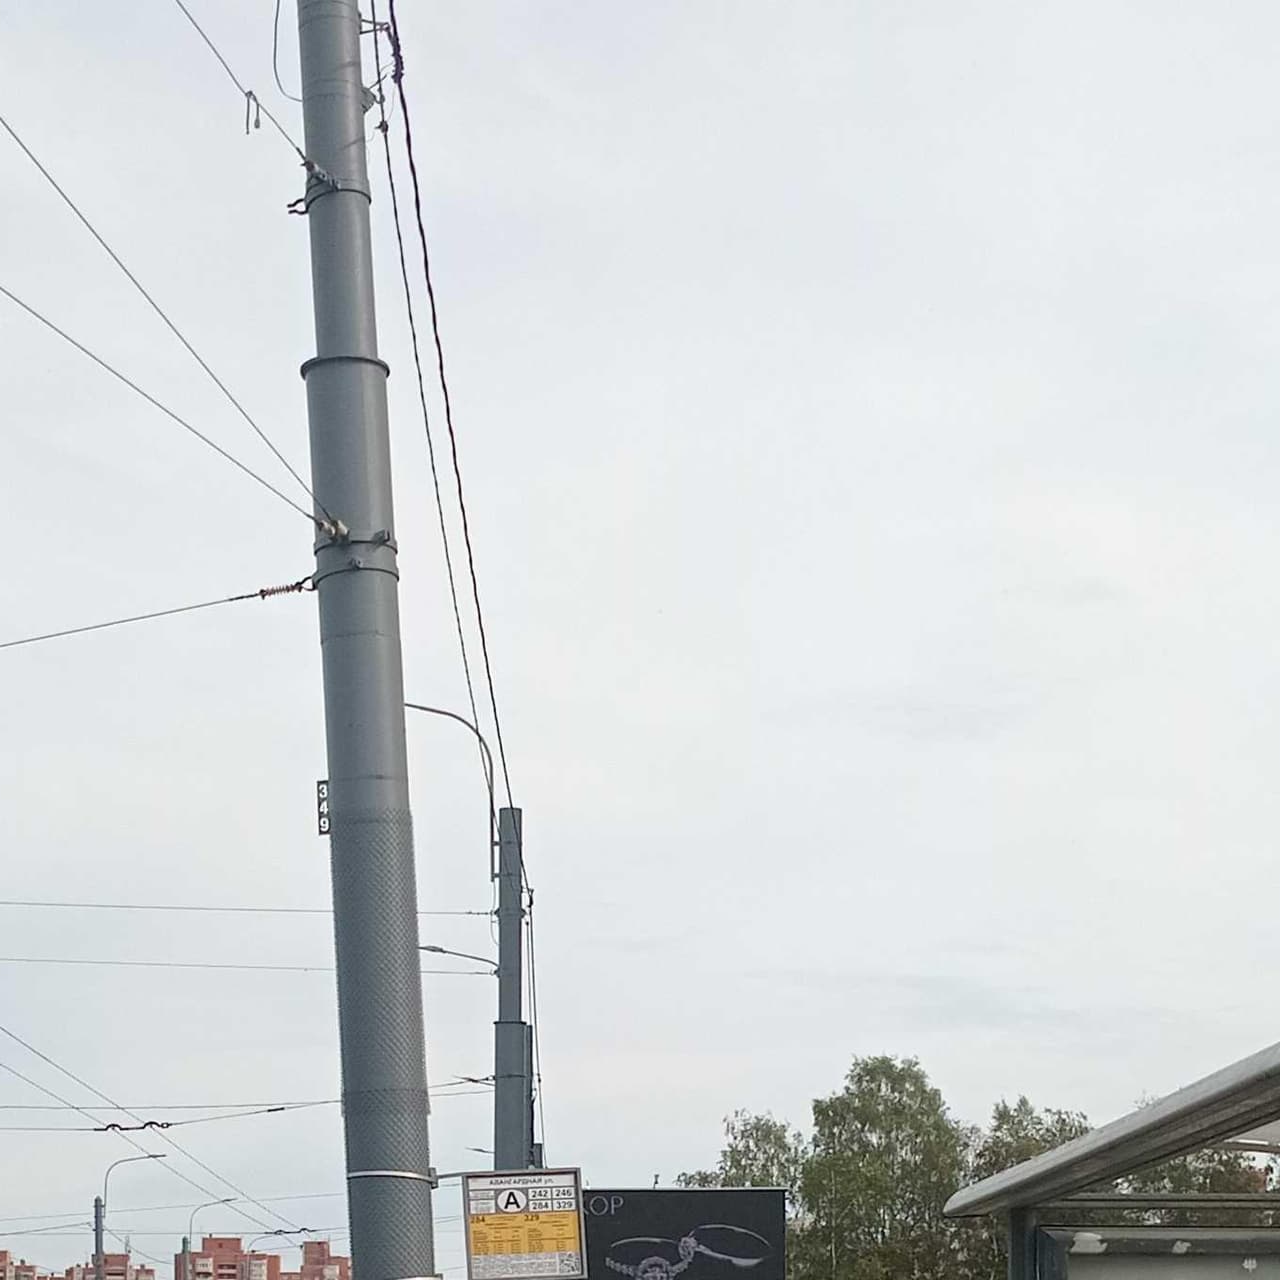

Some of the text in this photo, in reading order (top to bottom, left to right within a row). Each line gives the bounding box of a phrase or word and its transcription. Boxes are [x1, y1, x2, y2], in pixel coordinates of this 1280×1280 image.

[319, 784, 329, 831] 349
[531, 1190, 548, 1198] 242
[504, 1191, 520, 1209] А
[556, 1200, 572, 1209] 329
[532, 1201, 549, 1210] 284
